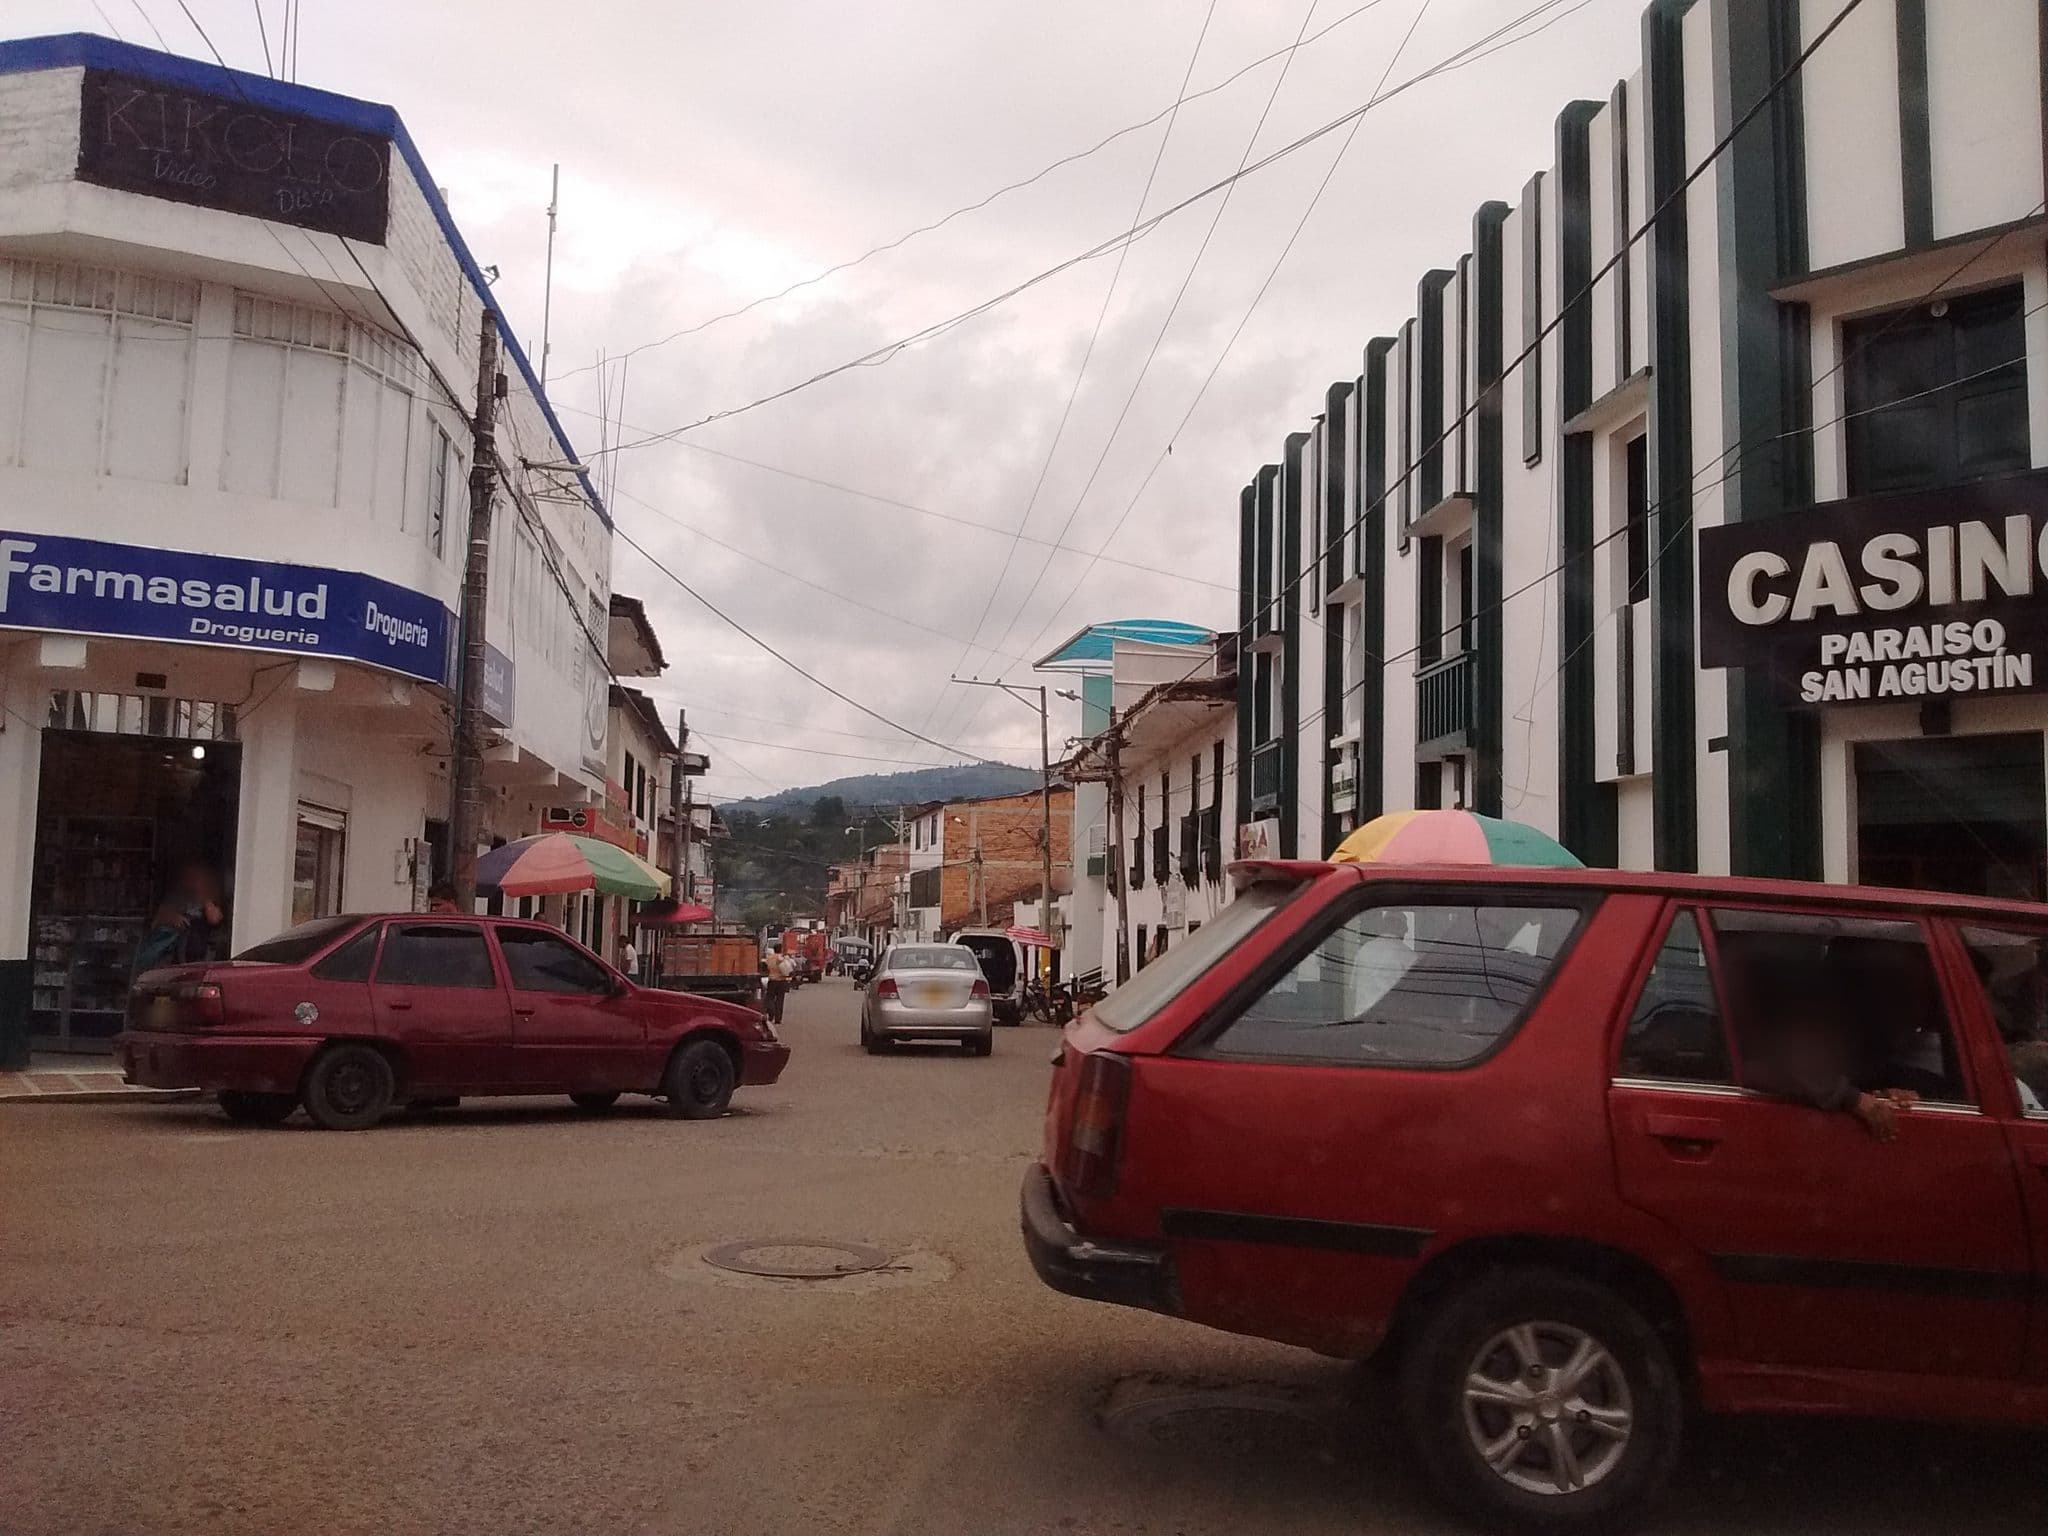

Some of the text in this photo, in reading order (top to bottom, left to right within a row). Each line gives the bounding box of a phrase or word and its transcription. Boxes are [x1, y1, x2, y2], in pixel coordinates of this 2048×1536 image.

[0, 539, 328, 620] Farmasalud
[1727, 513, 2048, 625] CASIN
[190, 617, 320, 645] Drogueria
[365, 600, 429, 648] Drogueria
[1821, 618, 2007, 665] PARAISO
[1801, 646, 2033, 702] SAN AGUSTÍN
